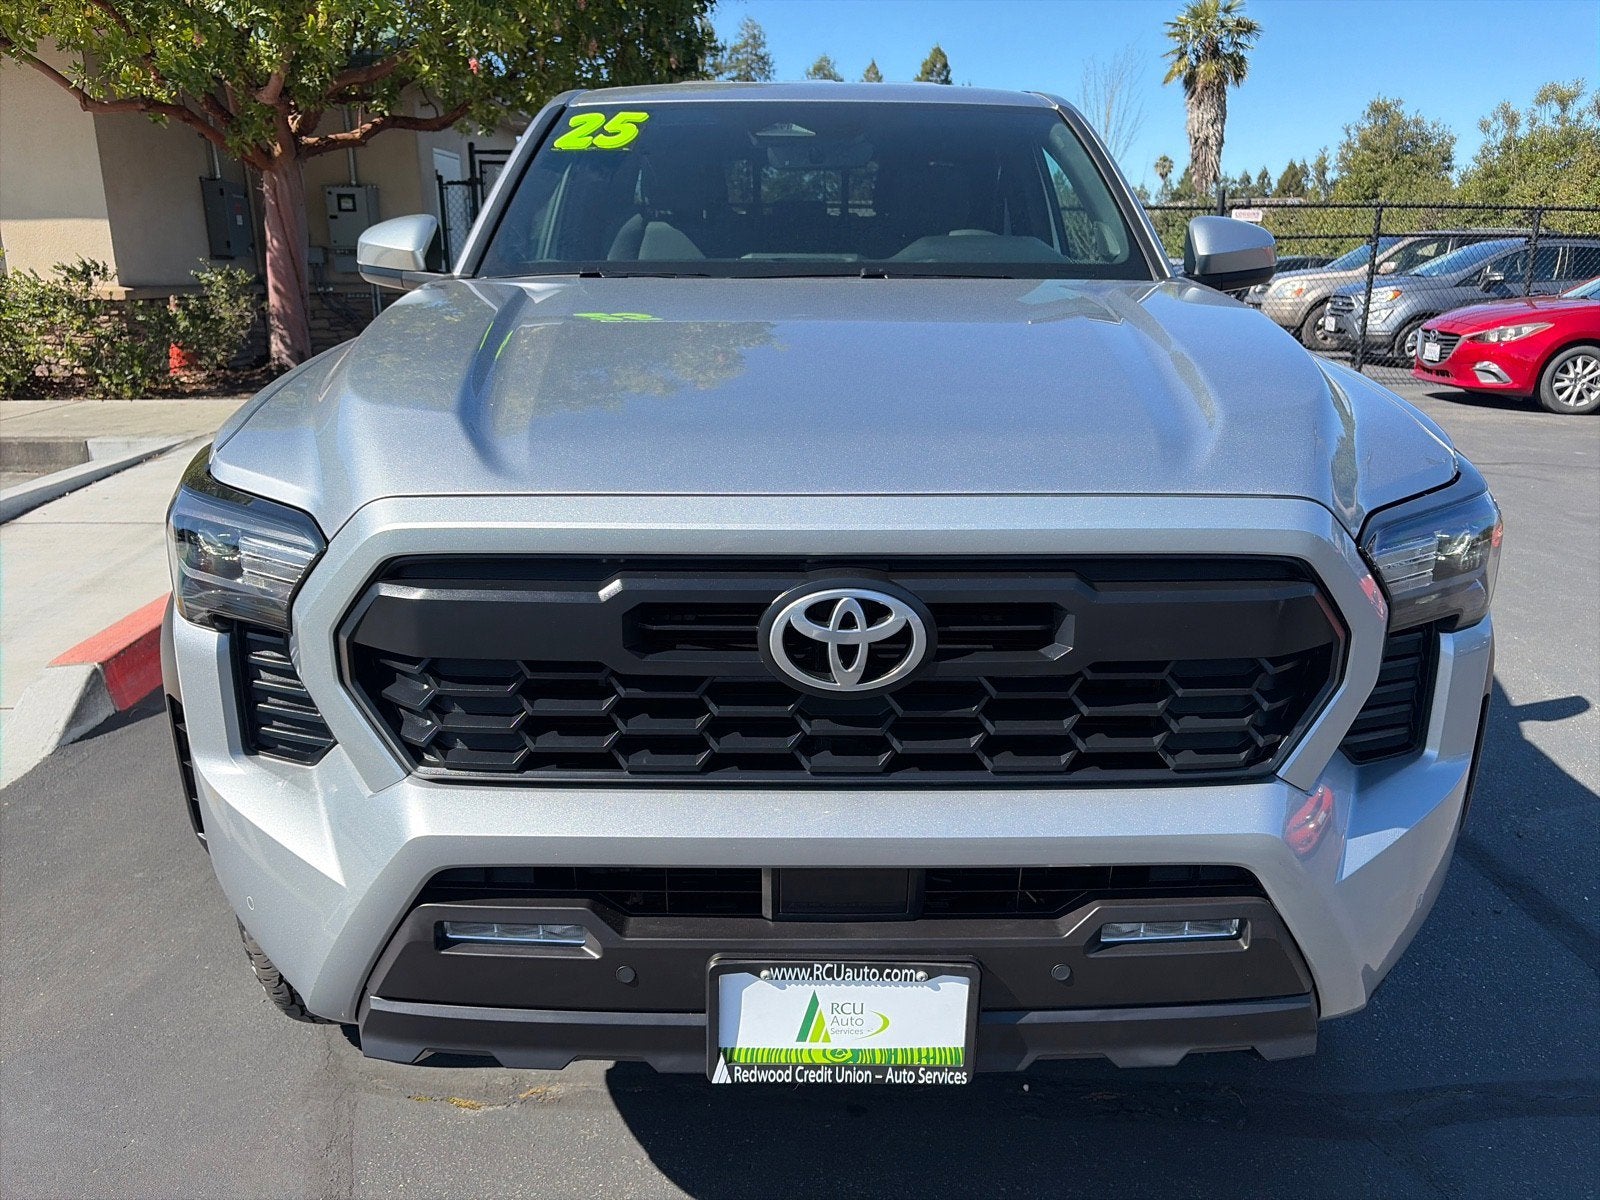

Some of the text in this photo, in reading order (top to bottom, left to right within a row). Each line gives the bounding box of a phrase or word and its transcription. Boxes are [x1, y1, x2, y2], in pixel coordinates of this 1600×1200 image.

[553, 111, 649, 150] 25
[770, 963, 916, 982] www.RCUauto.com
[831, 1002, 864, 1015] RCU
[830, 1015, 864, 1027] Auto
[830, 1027, 864, 1035] Services
[734, 1065, 792, 1083] Redwood
[795, 1065, 832, 1083] Credit
[835, 1066, 872, 1083] Union
[885, 1067, 916, 1084] Auto
[918, 1067, 968, 1085] Services
